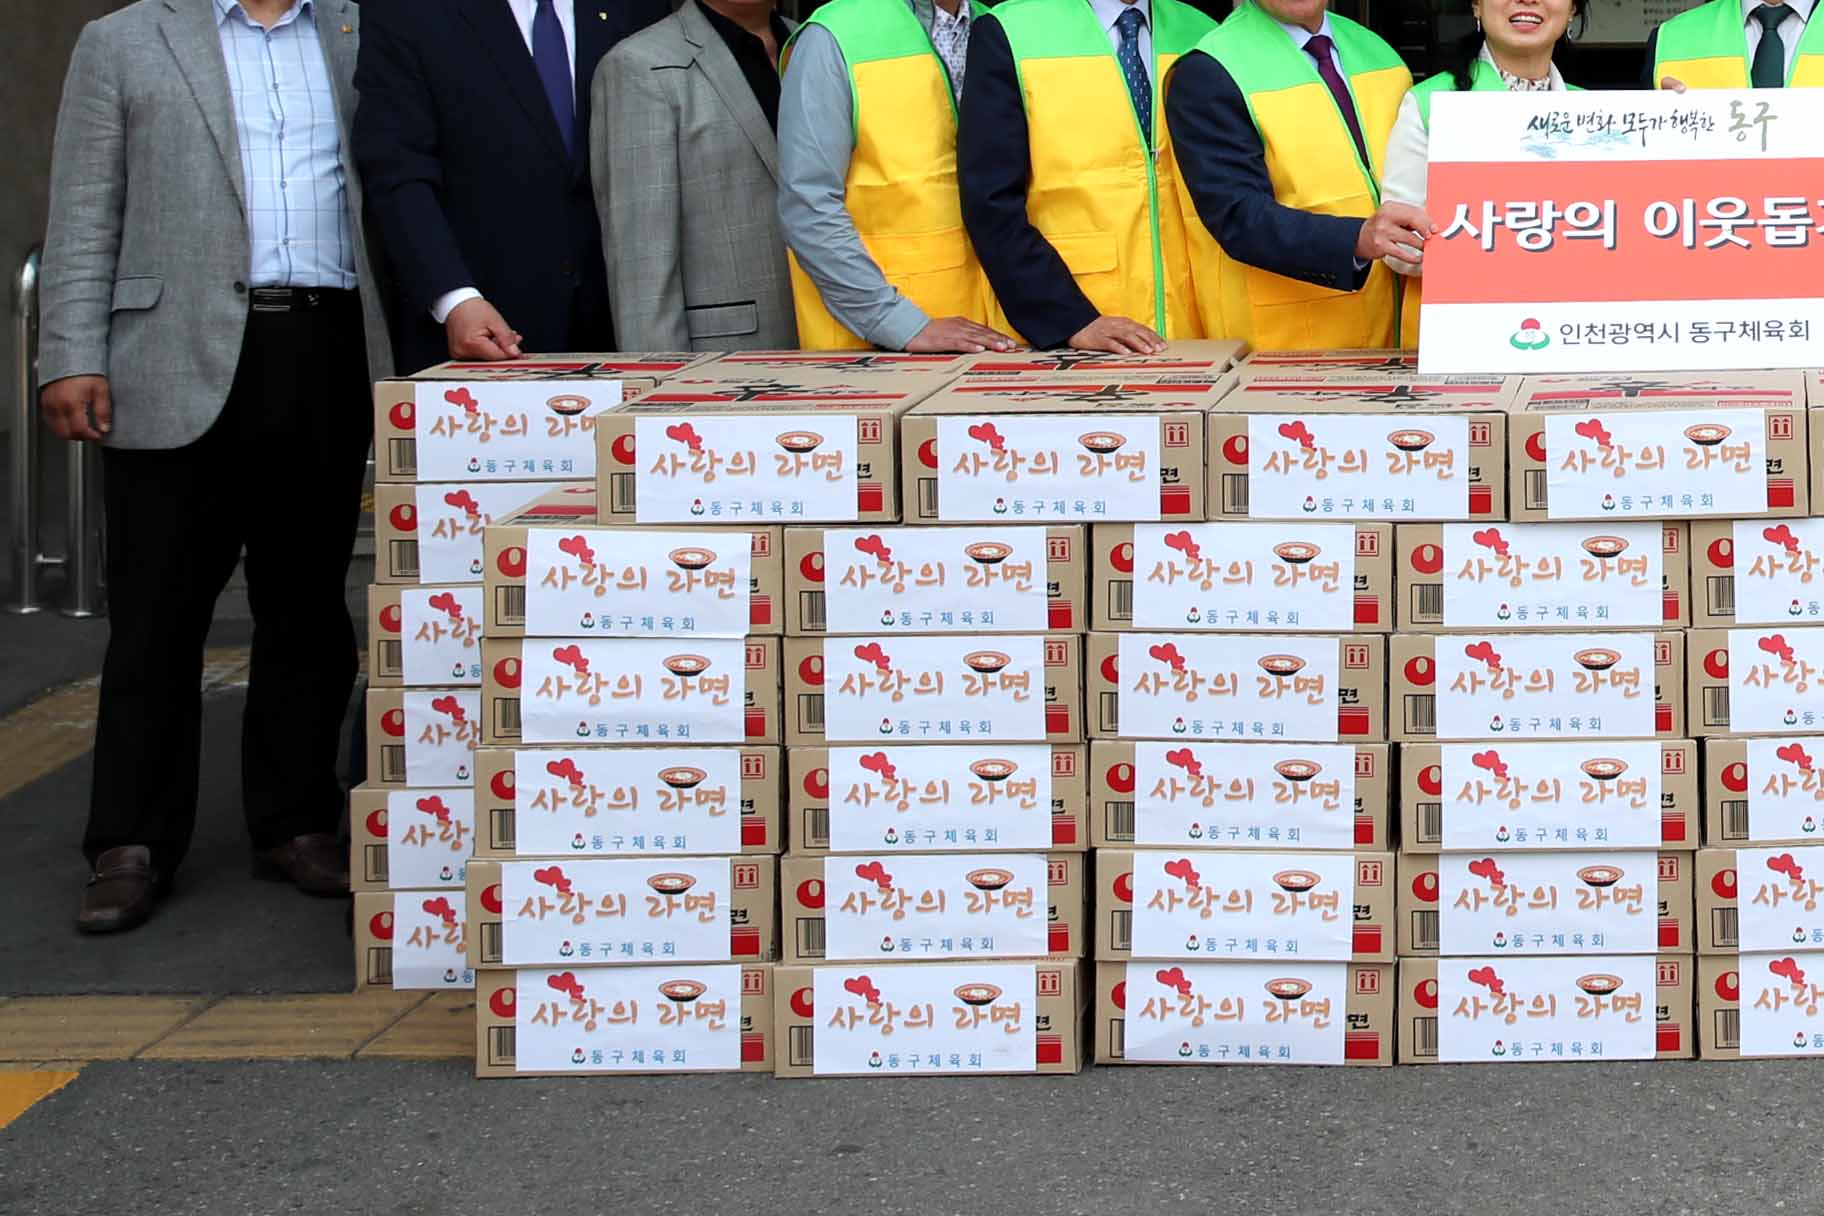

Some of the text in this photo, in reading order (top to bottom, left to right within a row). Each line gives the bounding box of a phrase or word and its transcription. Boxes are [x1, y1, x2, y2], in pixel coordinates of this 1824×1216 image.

[1621, 111, 1667, 147] 모두가
[1670, 109, 1715, 141] 행복한
[1728, 99, 1778, 152] 동구
[1439, 197, 1617, 252] 사랑의
[1559, 319, 1810, 346] 인천광역시 동구체육회
[430, 409, 529, 443] 사랑의
[651, 446, 843, 482] 사랑의 라면
[954, 446, 1146, 481] 사랑의 라면
[1262, 444, 1454, 481] 사랑의 라면
[539, 560, 736, 600] 사랑의 라면
[1149, 555, 1340, 593] 사랑의 라면
[1458, 551, 1648, 588] 사랑의 라면
[537, 669, 730, 705] 사랑의 라면
[840, 666, 1030, 703] 사랑의 라면
[1134, 666, 1325, 705] 사랑의 라면
[532, 781, 726, 817] 사랑의 라면
[846, 774, 1037, 812] 사랑의 라면
[1456, 774, 1647, 810] 사랑의 라면
[520, 888, 716, 924] 사랑의 라면
[1146, 883, 1340, 922] 사랑의 라면
[1455, 881, 1644, 917] 사랑의 라면
[529, 995, 726, 1032] 사랑의 라면
[826, 999, 1021, 1036] 사랑의 라면
[1138, 991, 1331, 1030] 사랑의 라면
